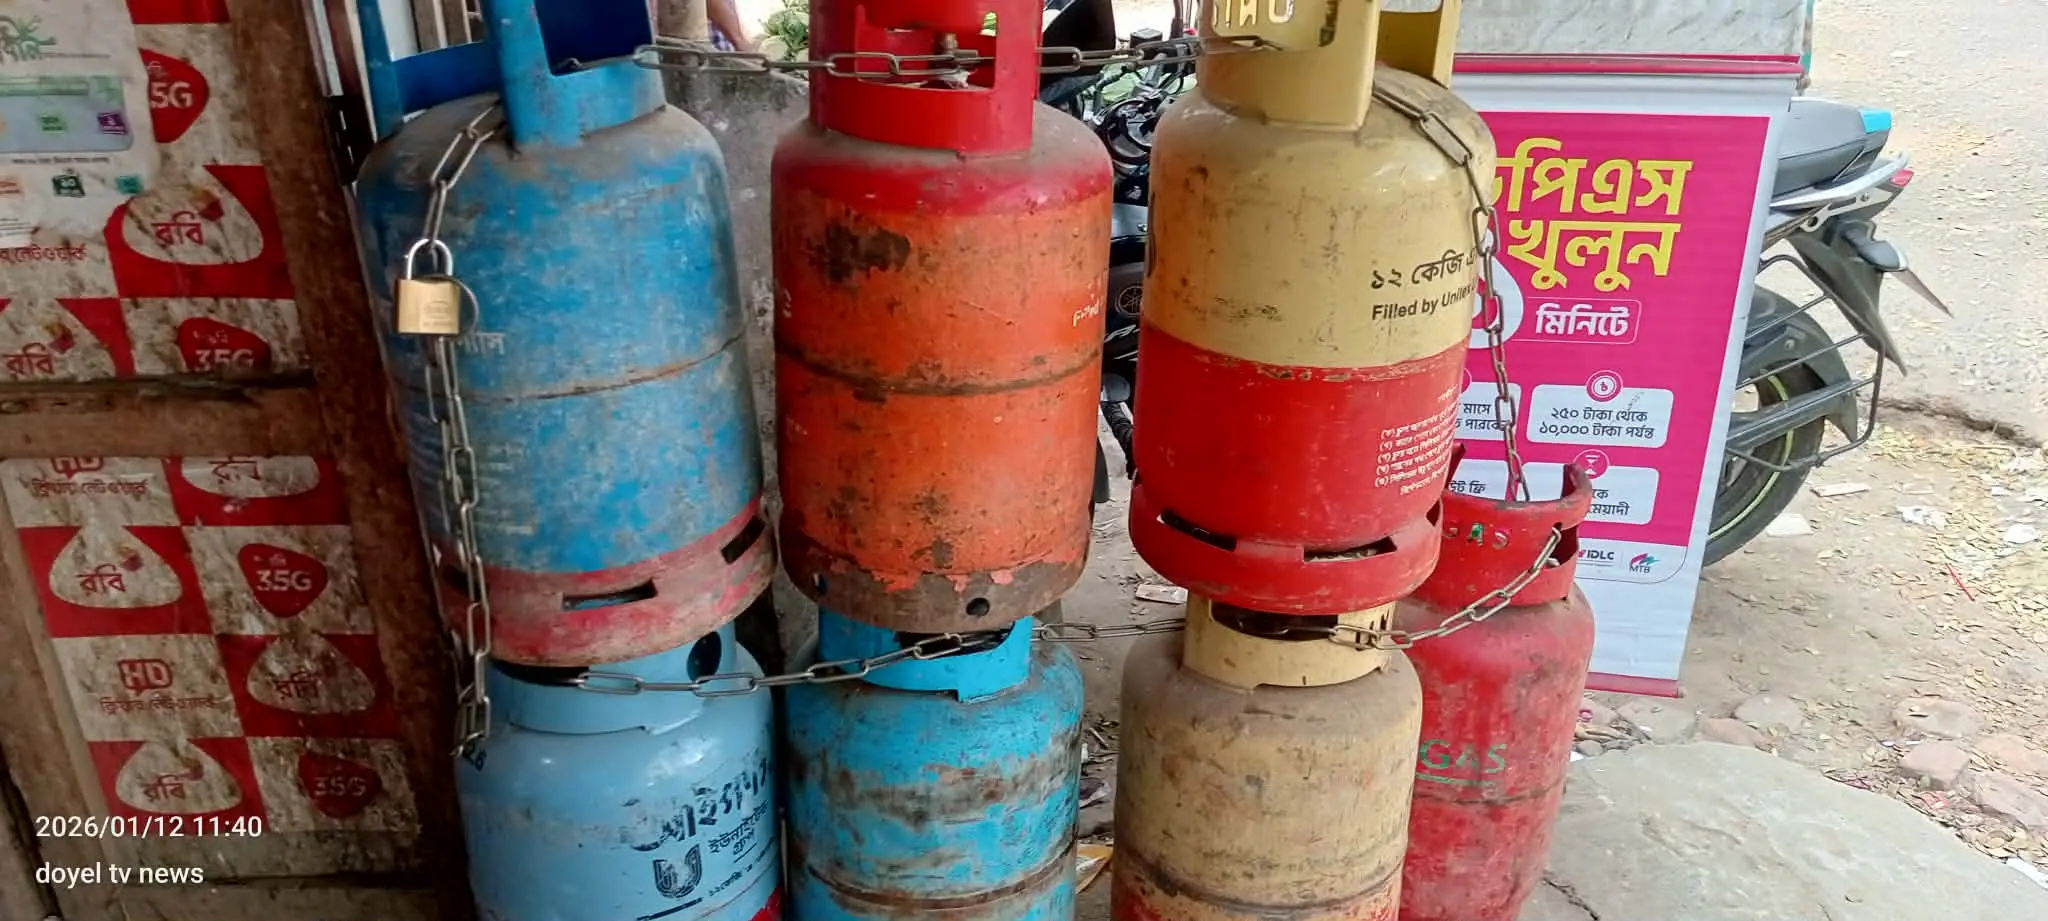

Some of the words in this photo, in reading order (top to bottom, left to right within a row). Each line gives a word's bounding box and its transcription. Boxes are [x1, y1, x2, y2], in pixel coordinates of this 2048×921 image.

[1491, 137, 1694, 216] পিএস
[152, 211, 205, 248] রবি
[1371, 268, 1402, 289] ১২
[1412, 249, 1464, 285] কেজি
[1507, 219, 1682, 292] খুলুন
[1372, 300, 1418, 320] Filled
[1421, 299, 1438, 315] by
[1535, 303, 1631, 337] মিনিটে
[2, 342, 54, 380] রবি
[1463, 403, 1492, 415] মাসে
[1551, 407, 1579, 420] ২৫০
[1583, 407, 1613, 421] টাকা
[1616, 409, 1648, 422] থেকে
[1539, 421, 1589, 436] ১০,০০০
[1592, 423, 1622, 437] টাকা
[1626, 424, 1655, 439] পর্যন্ত
[1586, 549, 1615, 561] IDLC
[1630, 563, 1650, 574] MTB
[76, 563, 126, 597] রবি
[119, 660, 171, 688] HD
[1419, 739, 1508, 775] GAS
[141, 773, 187, 802] রবি
